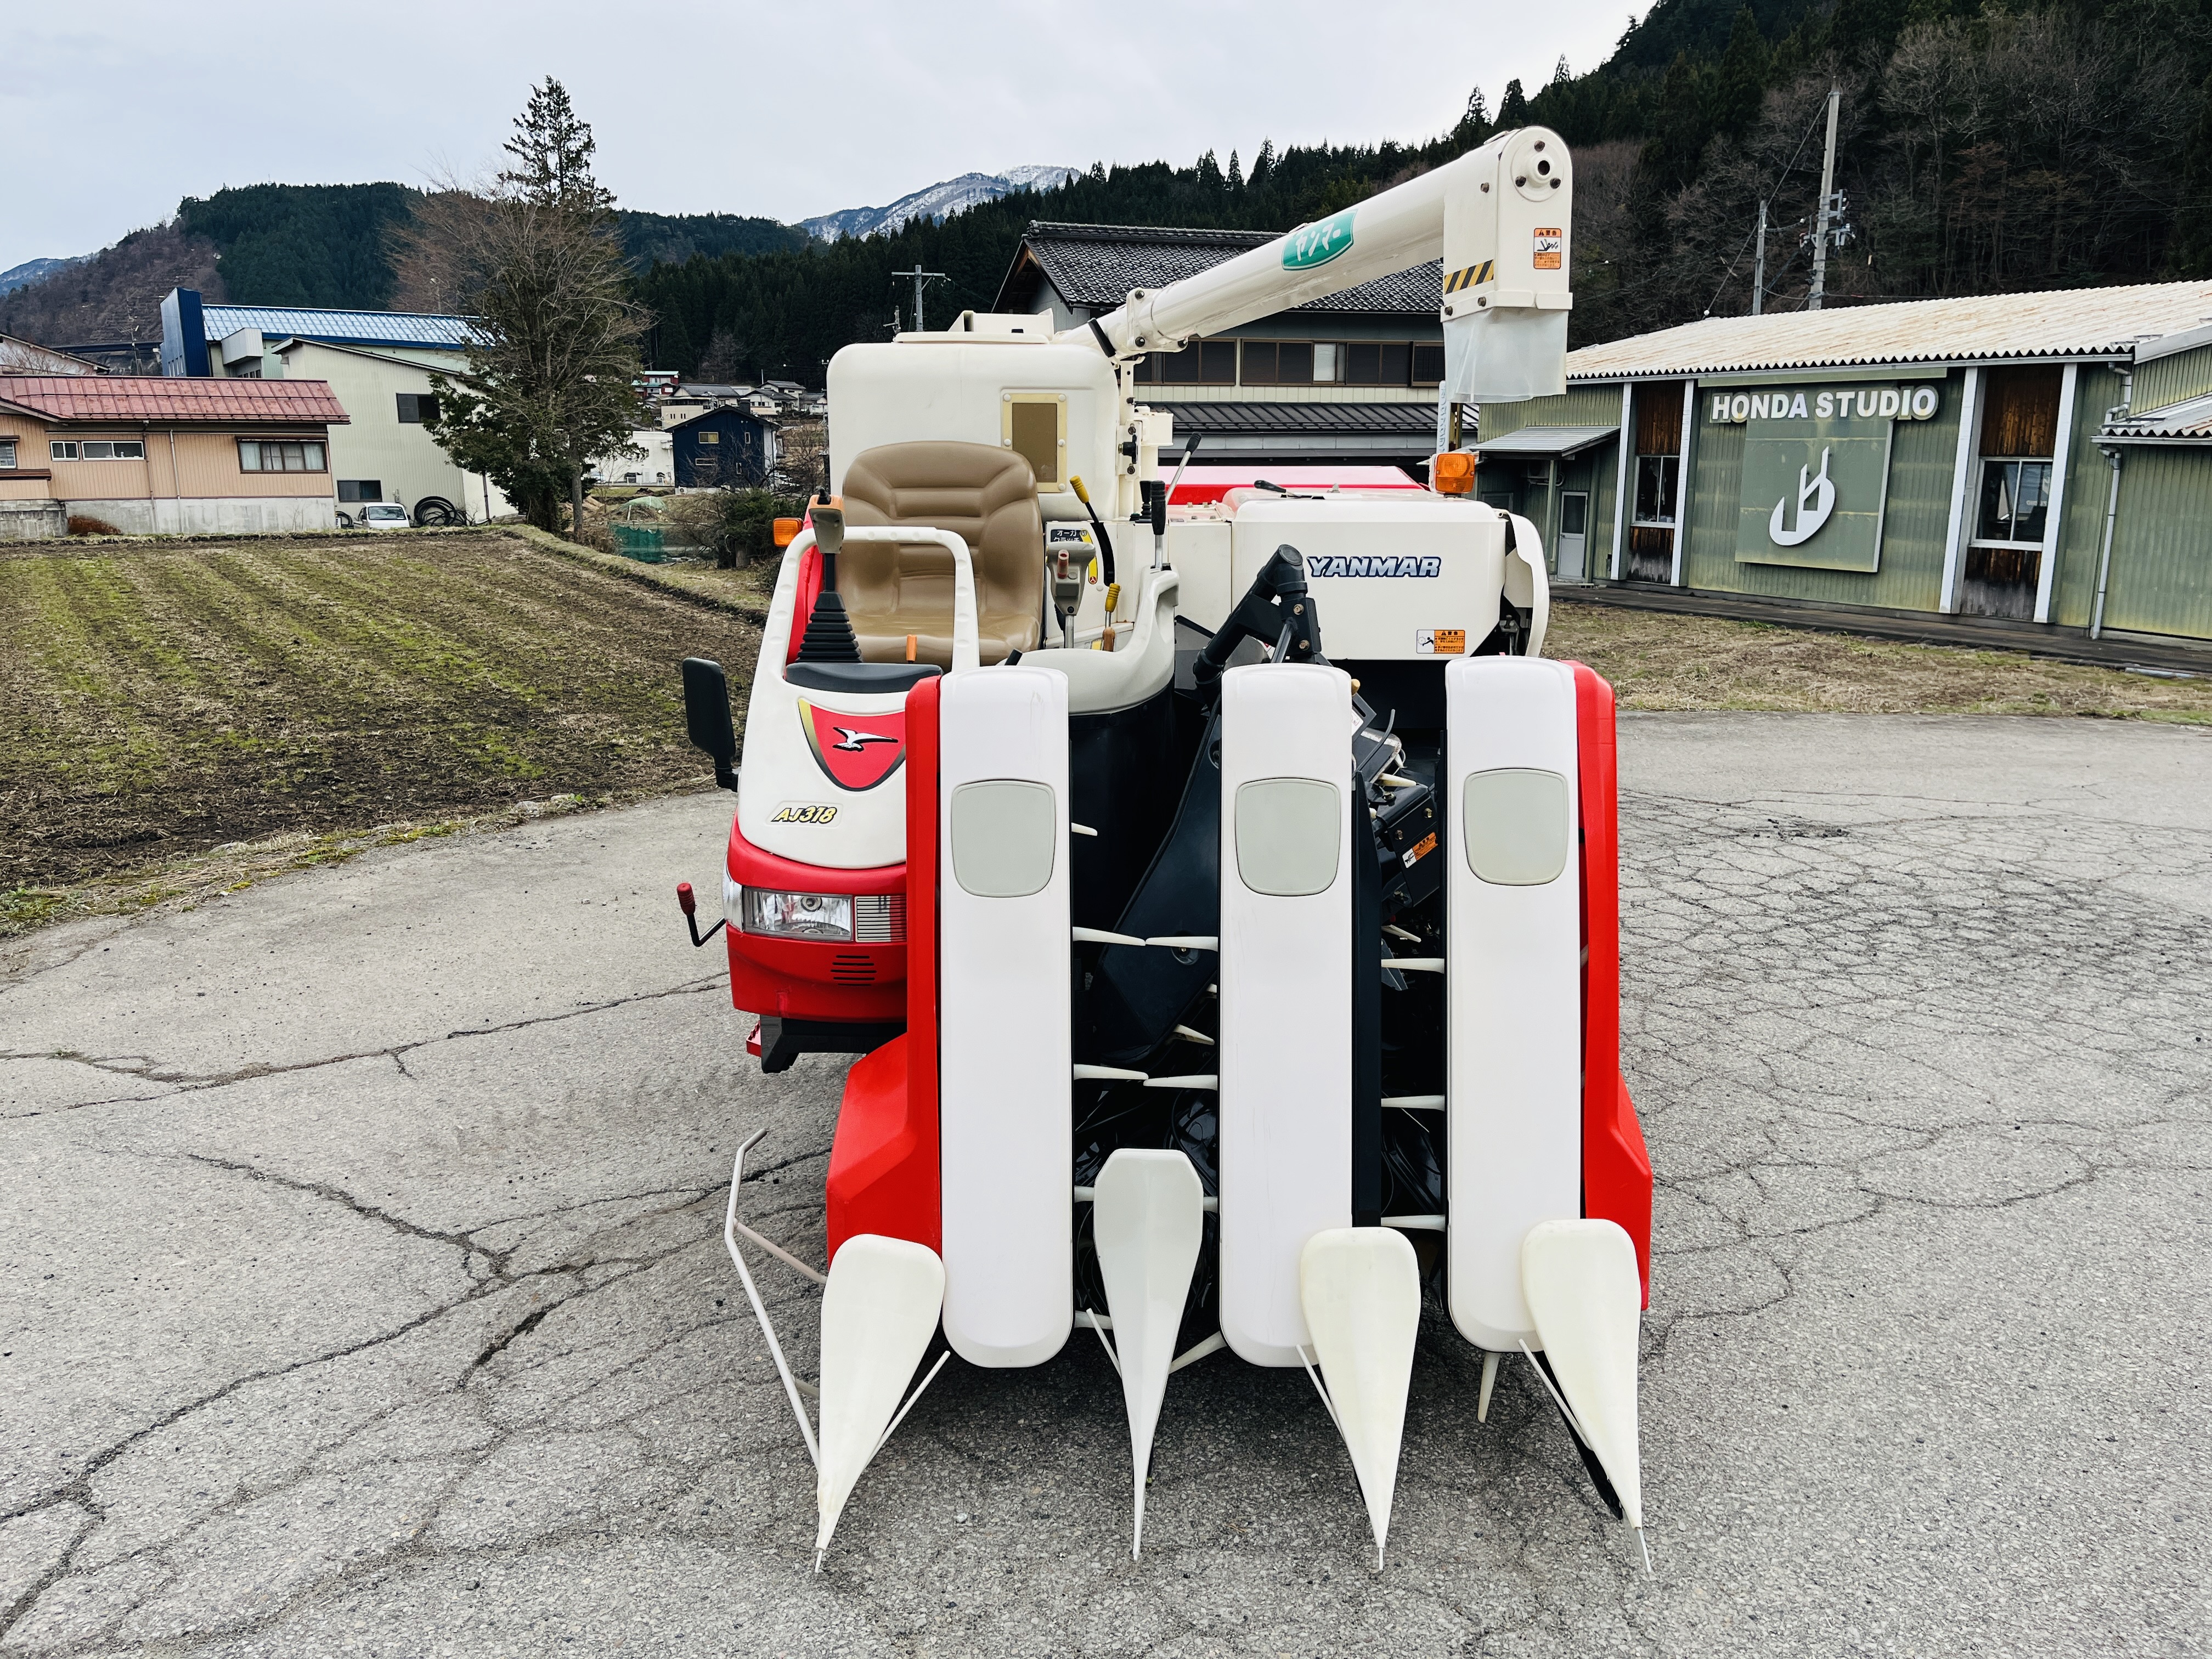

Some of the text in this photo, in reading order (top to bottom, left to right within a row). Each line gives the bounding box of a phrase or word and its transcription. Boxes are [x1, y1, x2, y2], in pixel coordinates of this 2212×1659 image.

[1712, 388, 1937, 420] HONDA STUDIO
[1307, 556, 1441, 578] YANMAR
[771, 806, 838, 824] AJ318
